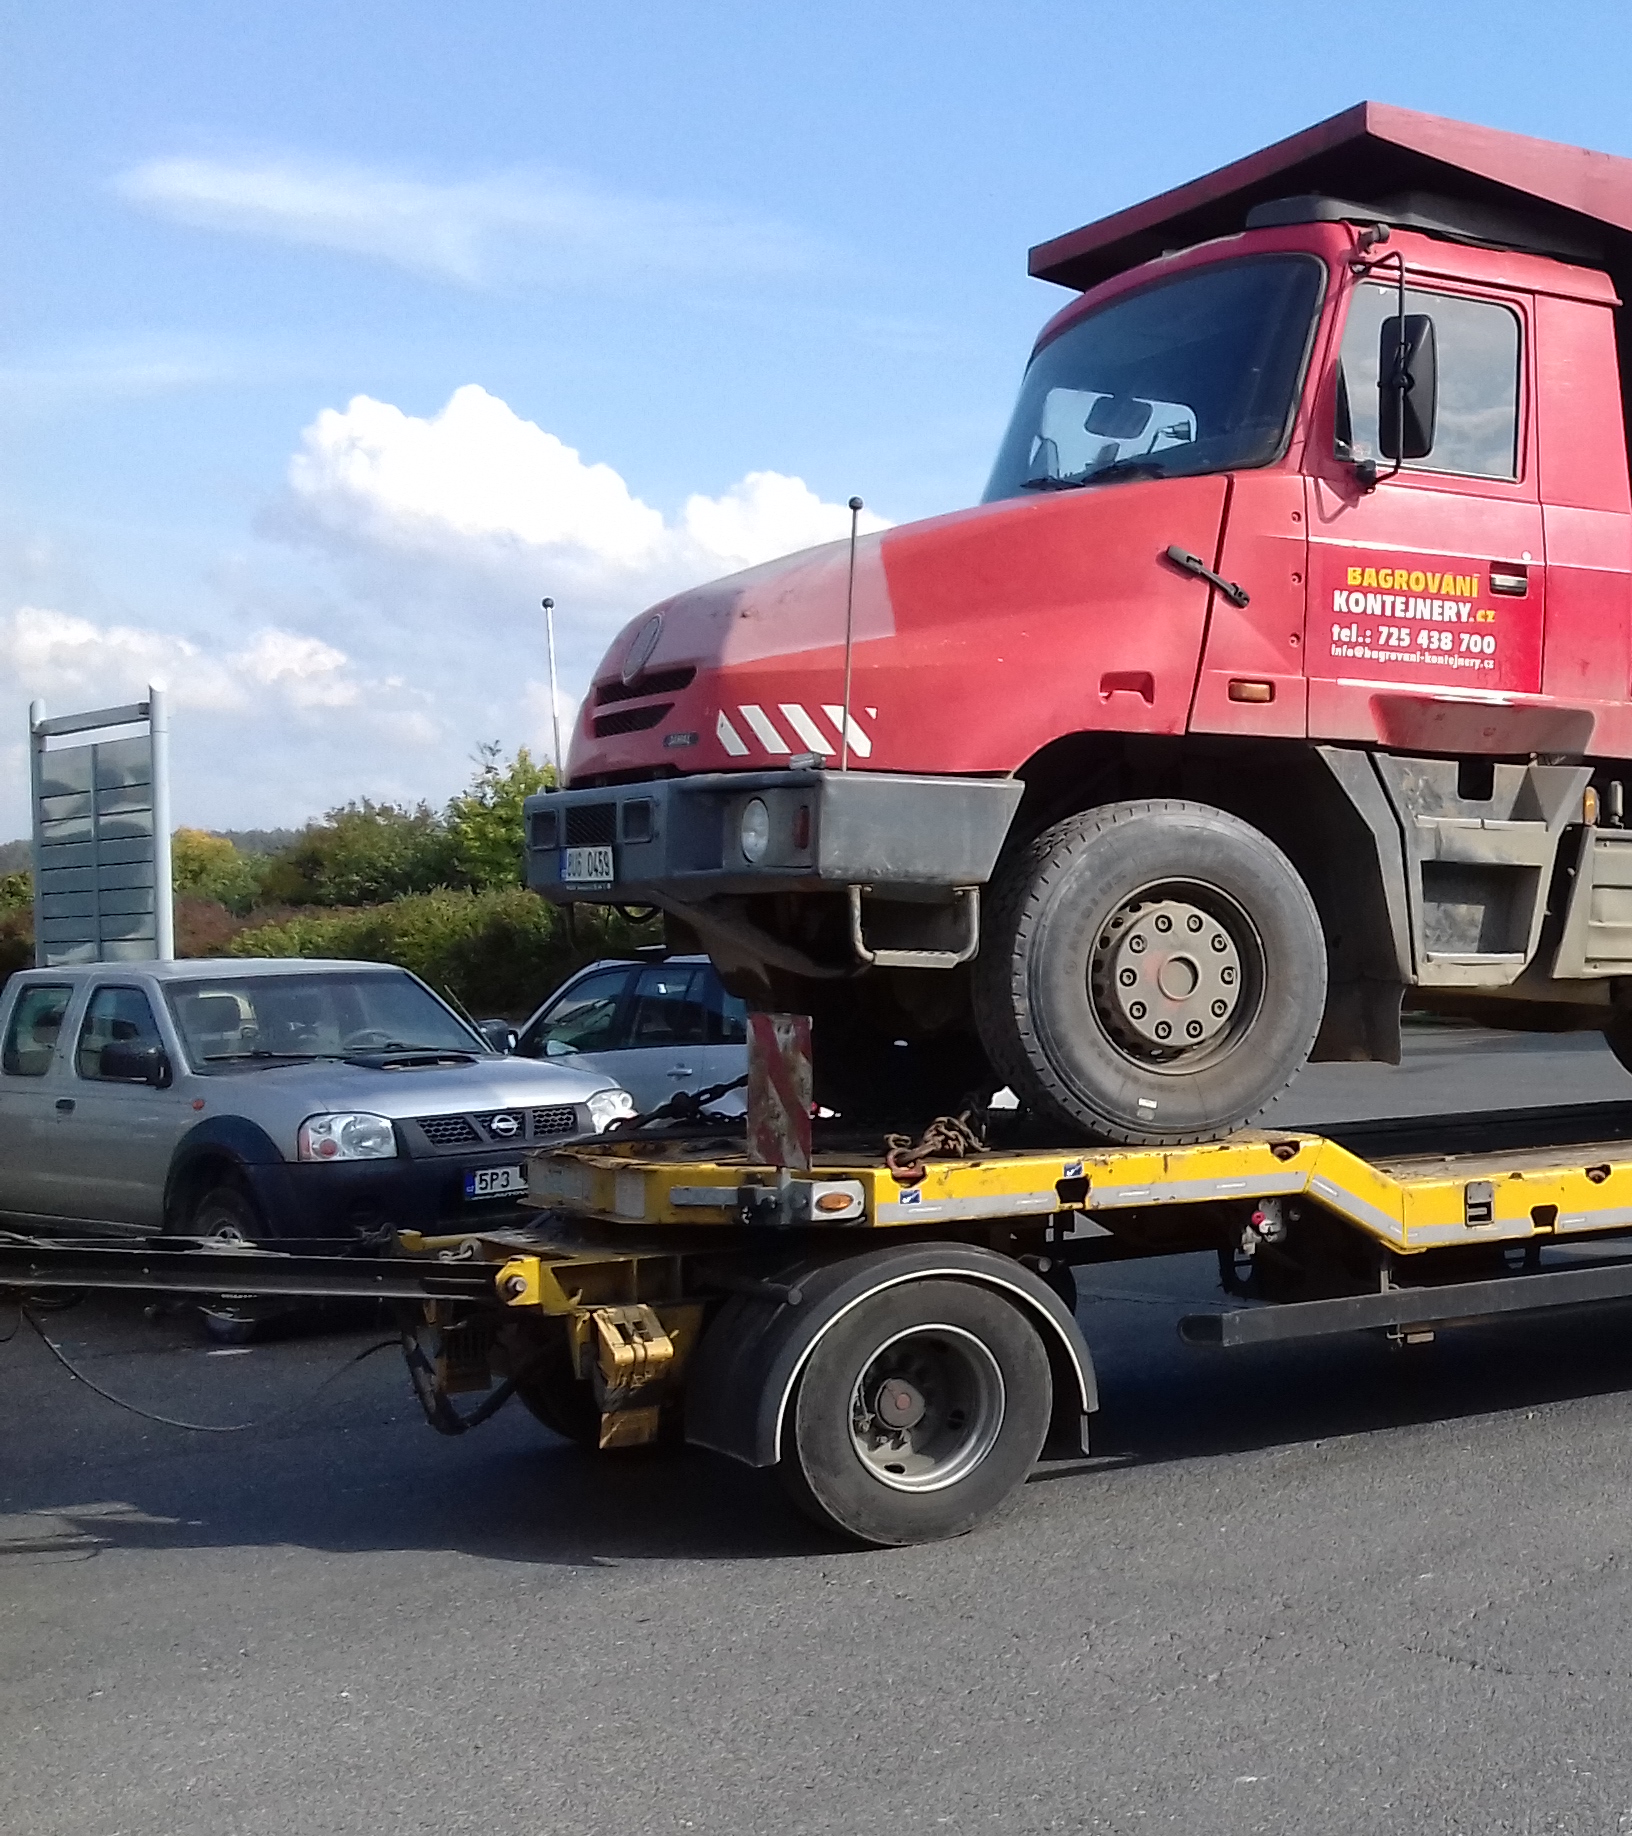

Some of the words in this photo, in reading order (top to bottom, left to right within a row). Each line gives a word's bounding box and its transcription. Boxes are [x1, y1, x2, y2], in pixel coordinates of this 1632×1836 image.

[1333, 589, 1496, 622] KONTEJNERY.cz
[1331, 623, 1372, 643] tel.:
[1378, 625, 1411, 647] 725
[1417, 629, 1453, 651] 438
[1459, 632, 1496, 654] 700
[478, 1171, 510, 1191] 5P3
